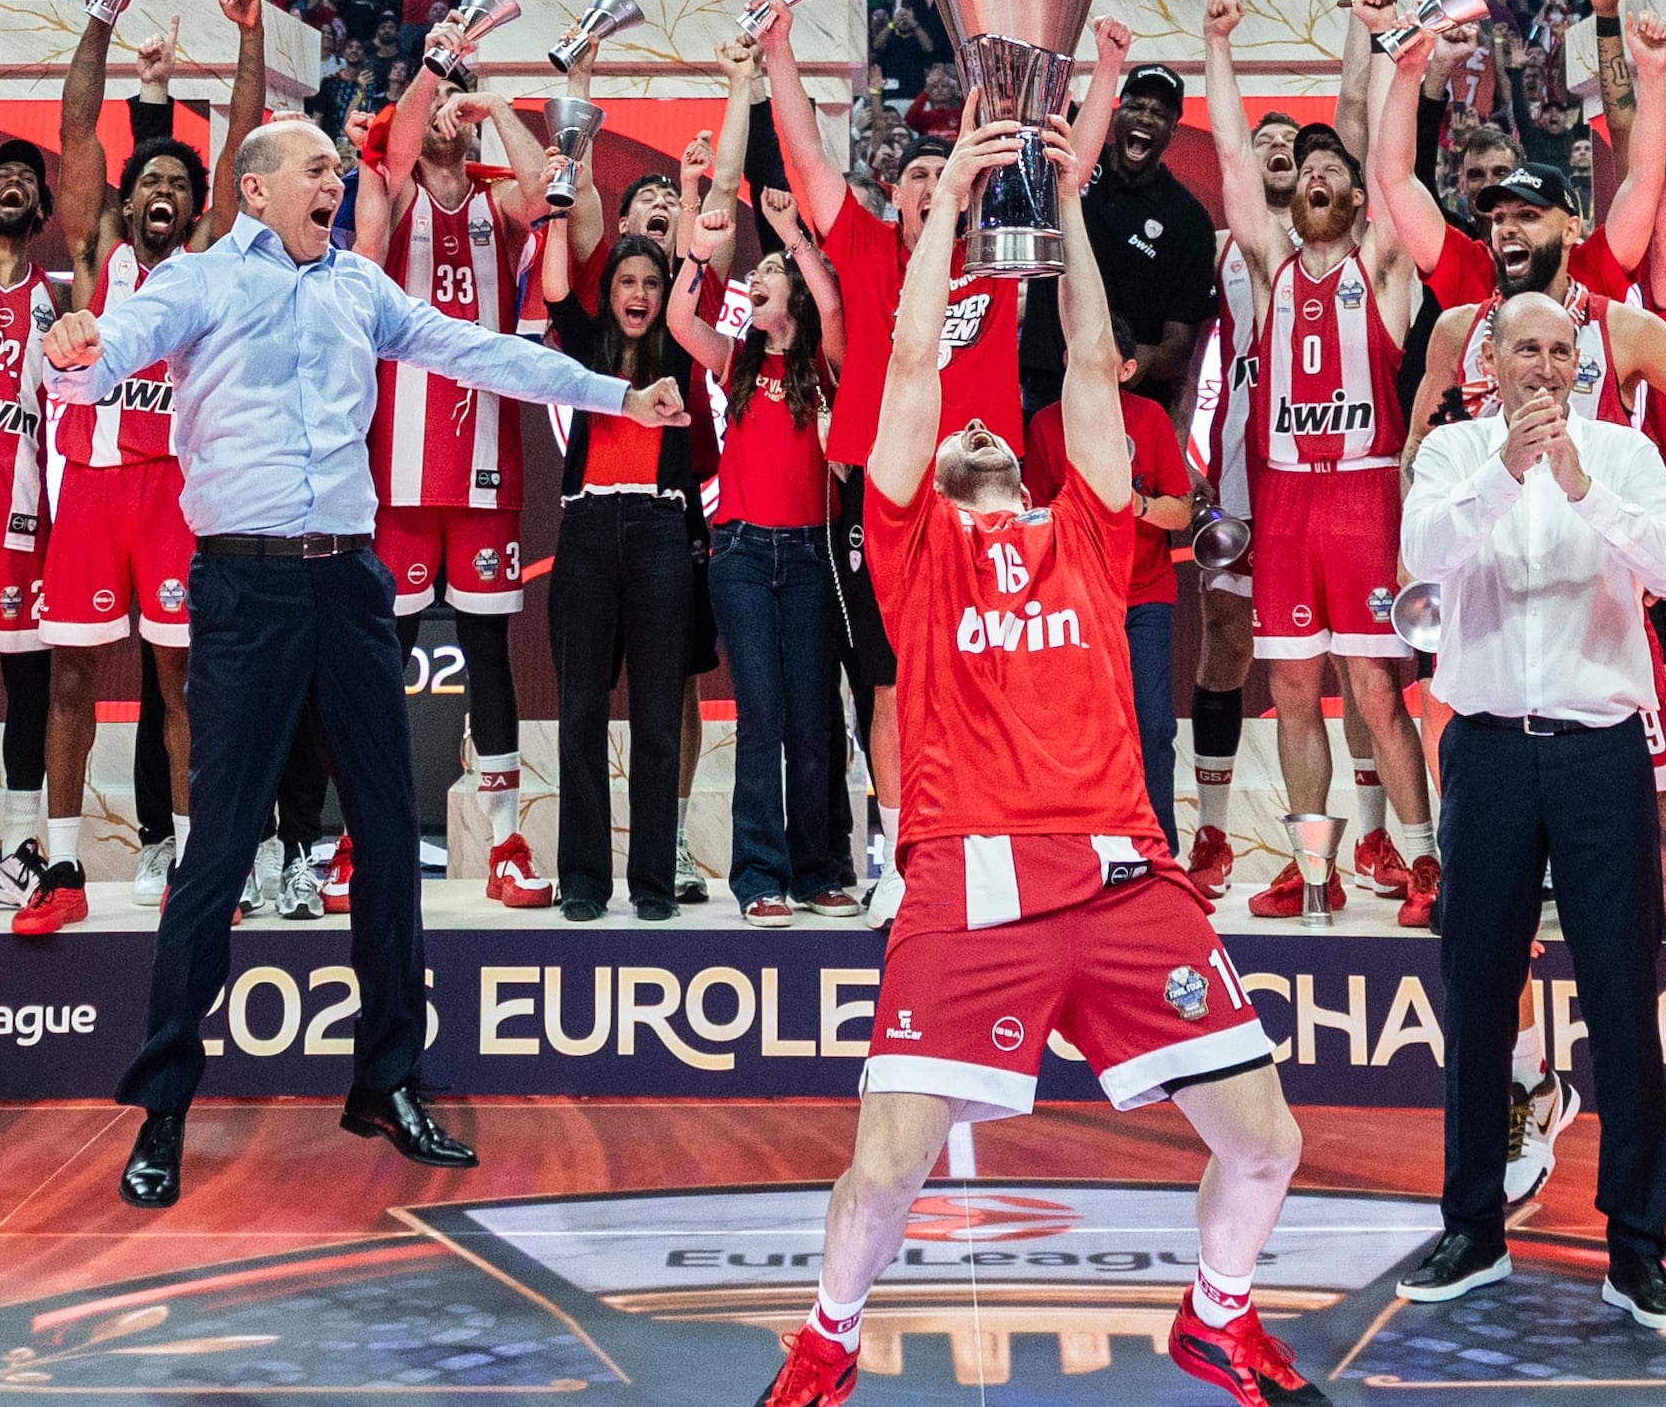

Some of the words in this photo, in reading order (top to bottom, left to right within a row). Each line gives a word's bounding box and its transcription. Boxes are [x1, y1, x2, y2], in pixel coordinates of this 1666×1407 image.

[1128, 234, 1158, 260] bwin
[435, 263, 475, 305] 33
[1302, 335, 1323, 375] 0
[97, 372, 177, 417] bwi
[1275, 389, 1375, 437] bwin
[986, 541, 1031, 595] 16
[956, 602, 1091, 655] bwin
[482, 774, 508, 787] SA
[1199, 771, 1232, 783] GSA
[203, 965, 439, 1057] 02
[886, 1028, 923, 1042] FlexCar
[995, 1026, 1021, 1040] GSA
[665, 1247, 1278, 1273] EurLeague
[1199, 1277, 1239, 1308] GSA
